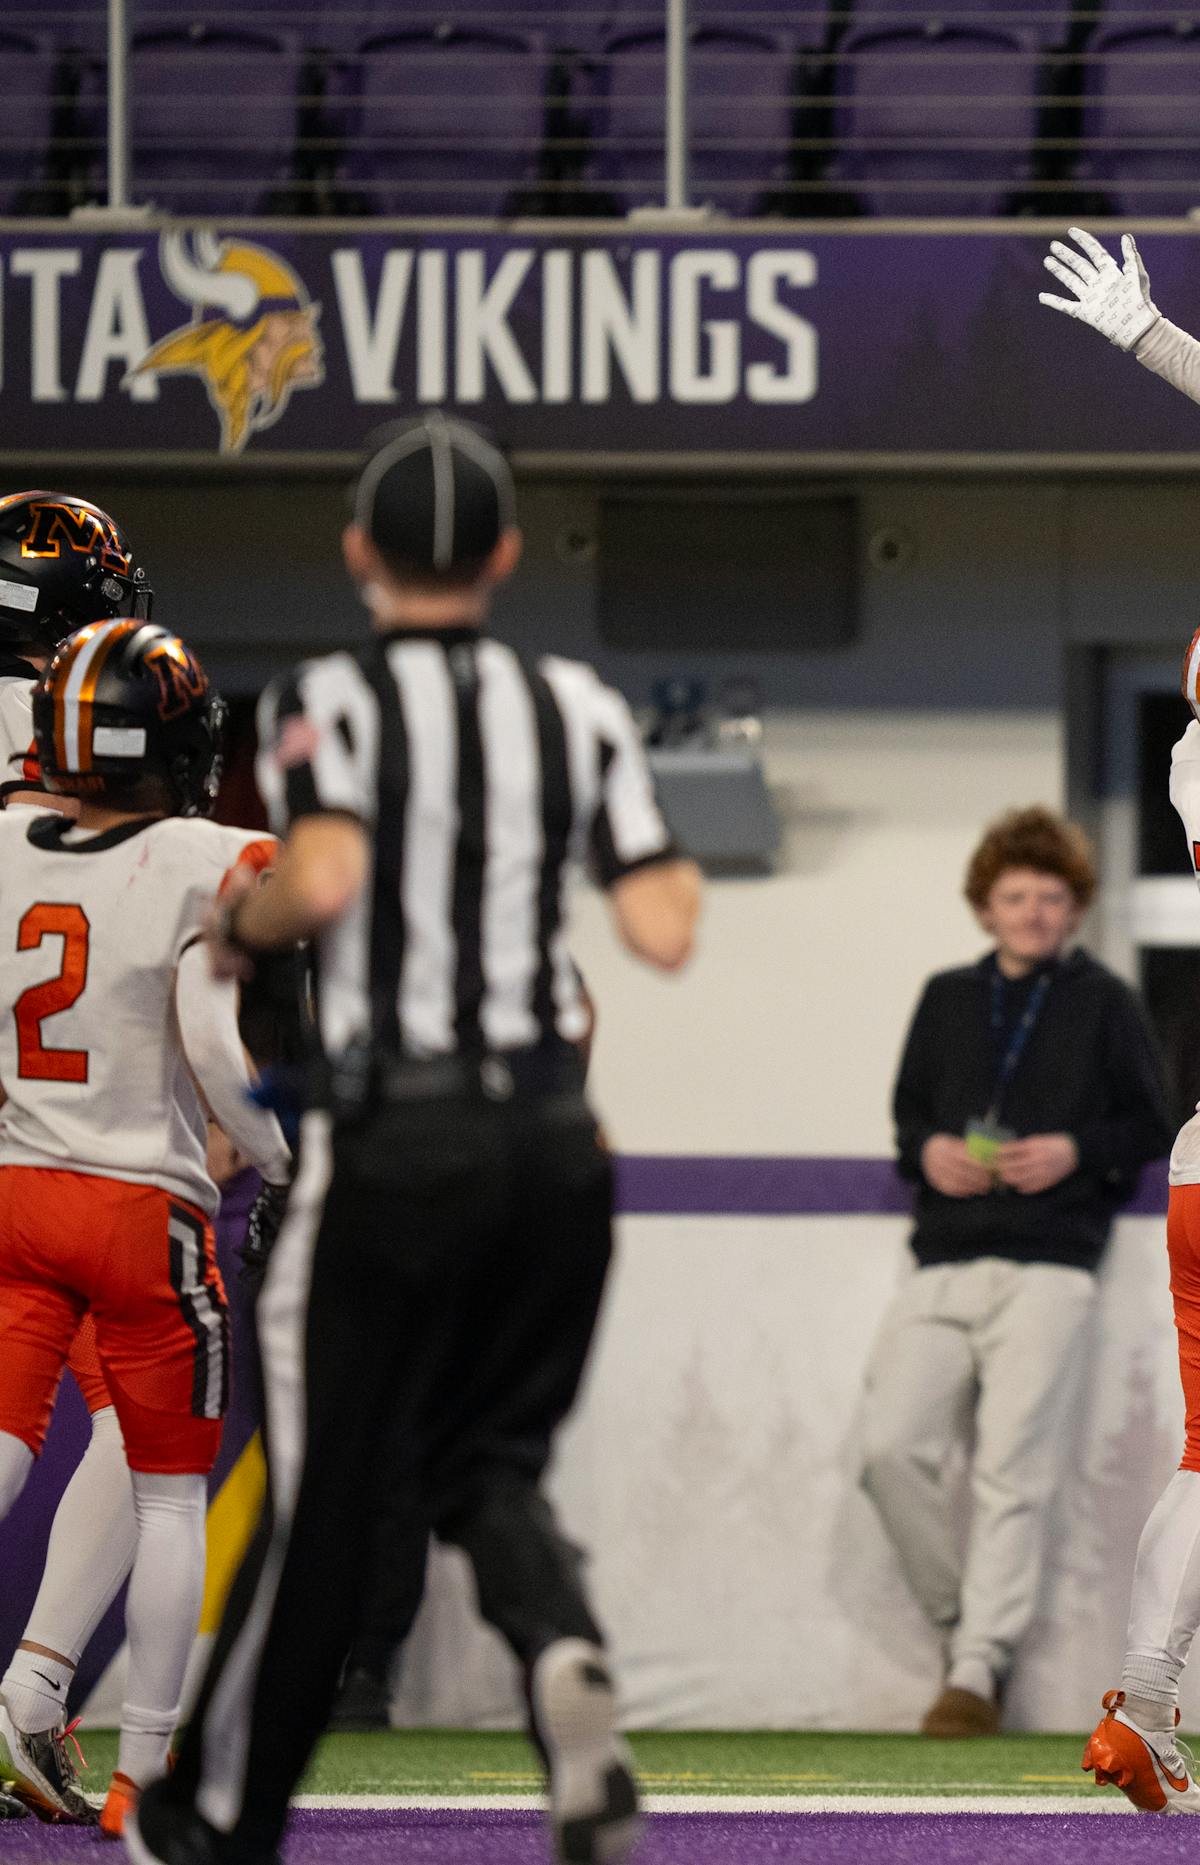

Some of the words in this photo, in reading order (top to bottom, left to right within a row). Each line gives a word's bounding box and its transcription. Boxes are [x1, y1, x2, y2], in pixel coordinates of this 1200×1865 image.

[0, 248, 159, 402] TA
[331, 249, 818, 403] VIKINGS
[21, 503, 129, 576] M
[12, 901, 90, 1084] 2
